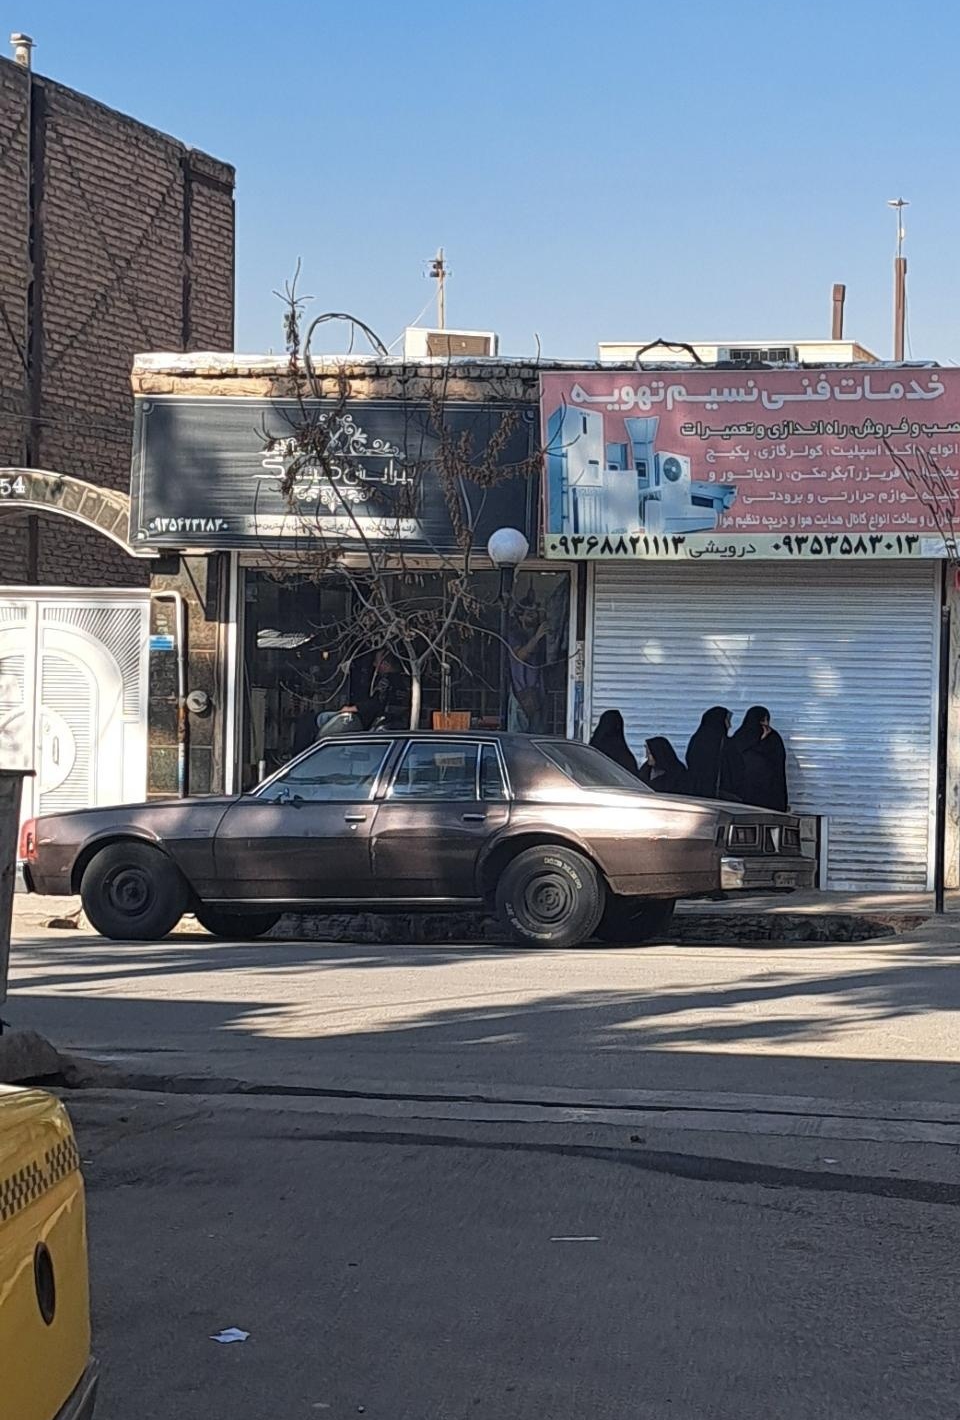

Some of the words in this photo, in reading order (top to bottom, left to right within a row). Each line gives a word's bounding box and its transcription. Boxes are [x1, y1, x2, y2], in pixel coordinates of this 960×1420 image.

[570, 380, 666, 411] تهویه
[667, 379, 759, 411] نسیم
[761, 373, 831, 410] فنی
[832, 373, 945, 401] خدمات
[681, 420, 755, 441] تعمیرات
[767, 420, 825, 439] اندازی
[825, 419, 848, 439] راه
[706, 445, 750, 463] پکیج
[930, 443, 959, 461] انواع
[720, 465, 783, 482] رادیاتور
[742, 489, 804, 504] برودتی
[817, 488, 875, 504] حرارتی
[718, 512, 735, 527] هوا
[736, 513, 761, 527] تنظیم
[797, 512, 813, 526] هوا
[815, 513, 844, 527] هدایت
[846, 513, 868, 528] کانال
[869, 512, 891, 530] انواع
[892, 512, 918, 525] ساخت
[550, 535, 686, 556] ۰۹۳۶۸۸۲۱۱۱۳
[688, 539, 757, 558] درویشی
[771, 534, 920, 556] ۰۹۳۵۳۵۸۳۰۱۳
